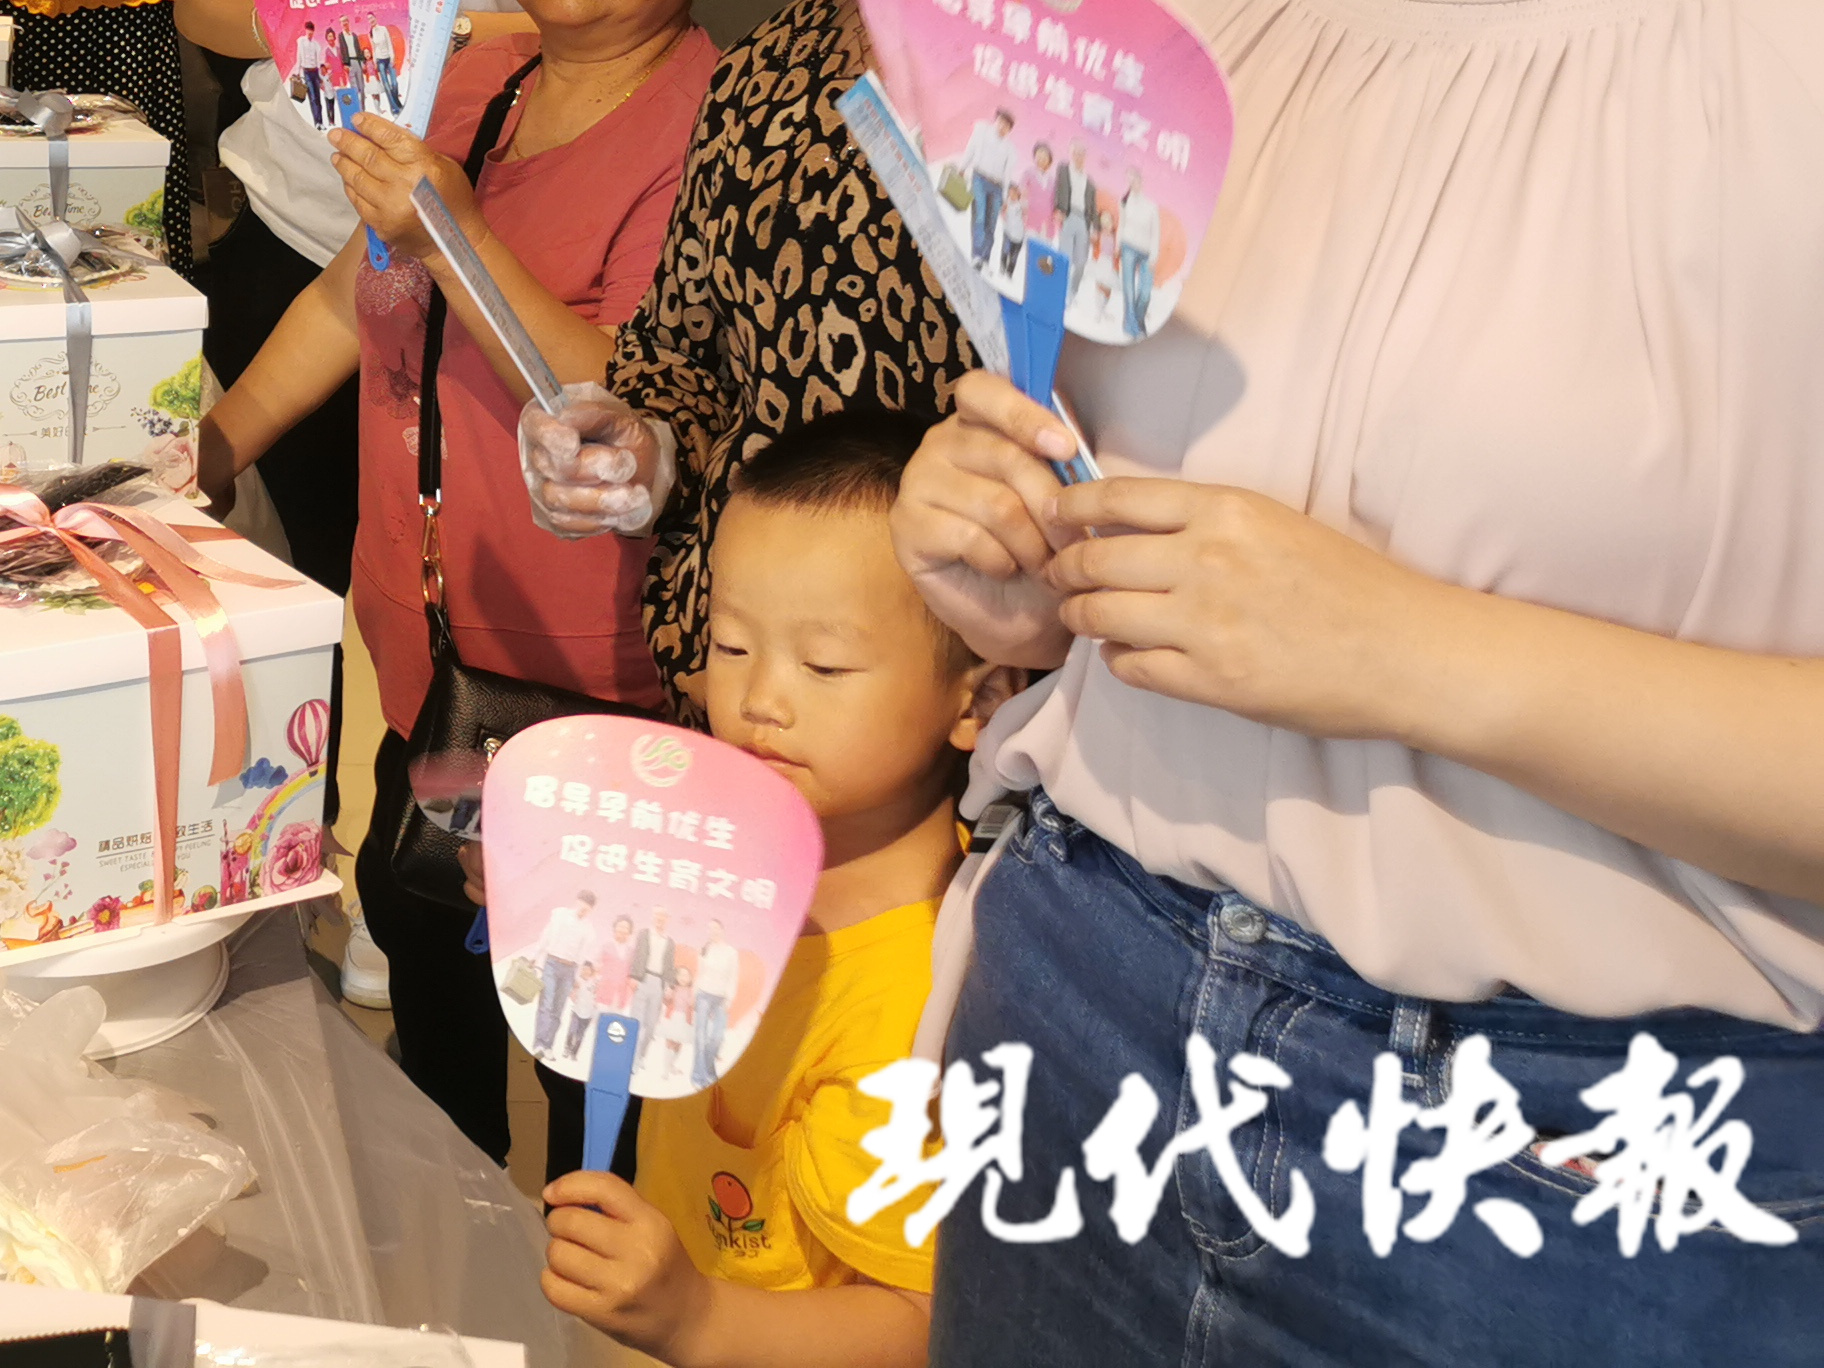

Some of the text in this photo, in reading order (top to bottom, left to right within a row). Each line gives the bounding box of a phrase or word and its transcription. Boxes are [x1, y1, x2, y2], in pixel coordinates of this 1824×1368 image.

[34, 382, 67, 401] Best
[524, 775, 735, 850] 倡导孕前优生
[560, 834, 776, 910] 促进生育文明
